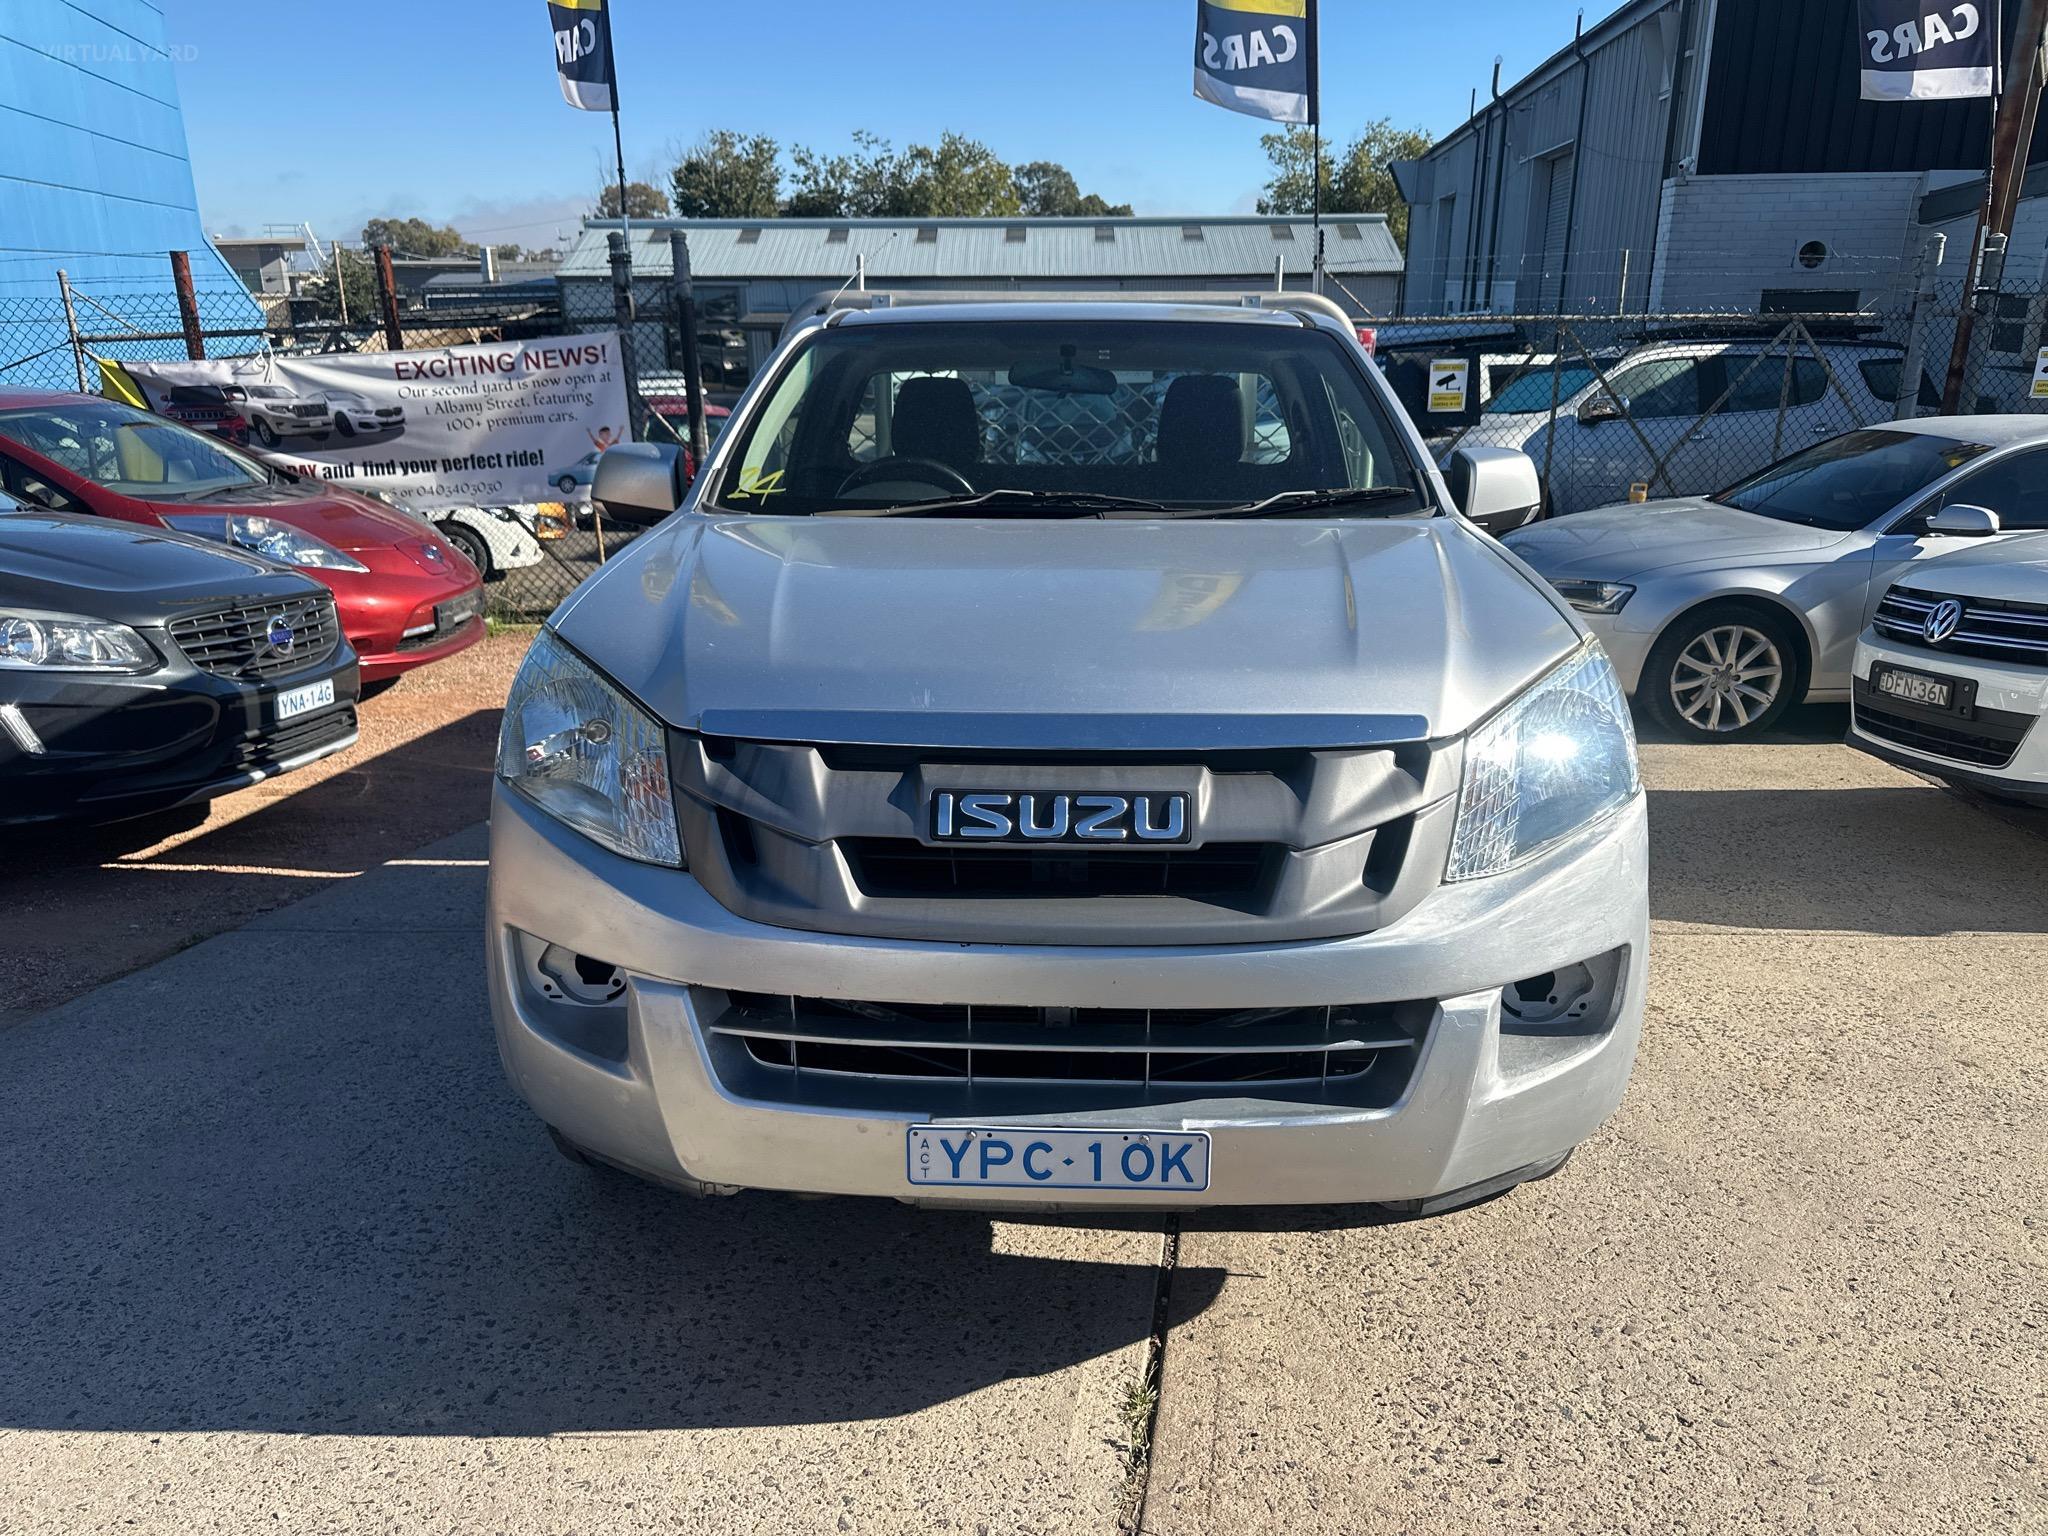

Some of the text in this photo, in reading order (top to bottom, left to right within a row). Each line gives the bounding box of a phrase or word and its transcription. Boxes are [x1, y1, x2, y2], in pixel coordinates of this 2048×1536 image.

[395, 344, 607, 380] EXCITING NEWS!
[398, 371, 612, 399] Our second yard is now open at
[434, 399, 483, 416] Albany
[534, 390, 594, 407] featuring
[487, 411, 546, 432] premium
[322, 462, 355, 480] and
[363, 459, 396, 476] find
[400, 458, 437, 476] your
[442, 450, 501, 472] perfect
[506, 449, 544, 467] ride!
[416, 480, 503, 497] 0403403030
[936, 793, 1185, 840] ISUZU
